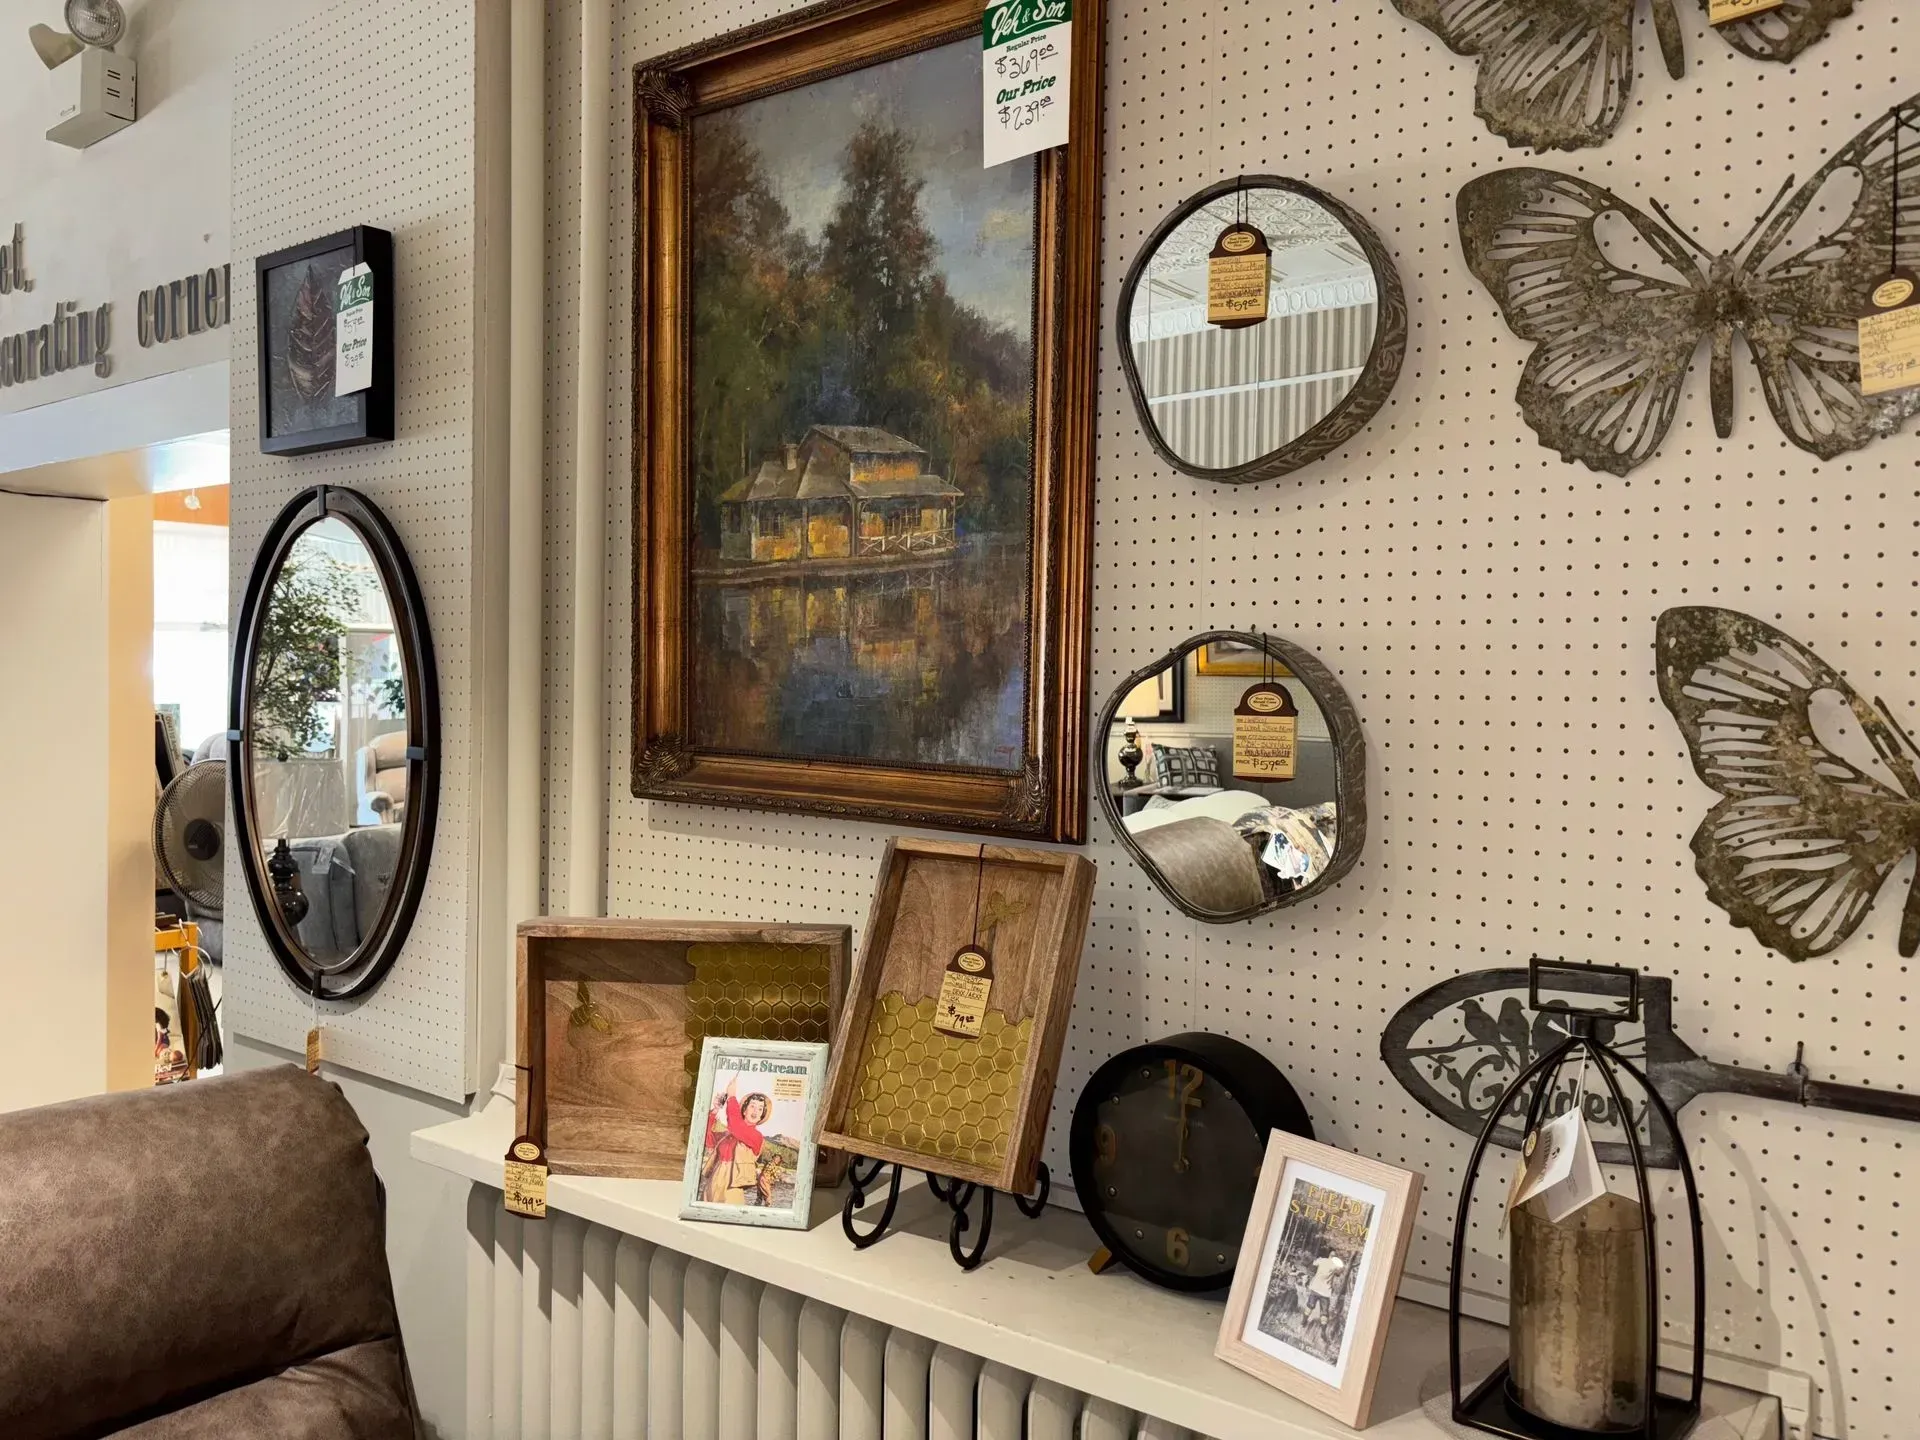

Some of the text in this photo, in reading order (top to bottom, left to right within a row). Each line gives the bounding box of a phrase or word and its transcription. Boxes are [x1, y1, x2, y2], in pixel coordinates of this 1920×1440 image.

[1022, 7, 1031, 23] &
[1033, 0, 1066, 21] Son
[1005, 33, 1047, 53] Regular Price
[996, 75, 1056, 105] Our Price
[352, 337, 368, 352] Price
[717, 1056, 751, 1072] Field
[760, 1059, 808, 1076] Stream
[1163, 1060, 1204, 1108] 12
[1307, 1183, 1362, 1217] FIELD
[1289, 1199, 1370, 1240] STREAM
[1166, 1226, 1189, 1270] 6
